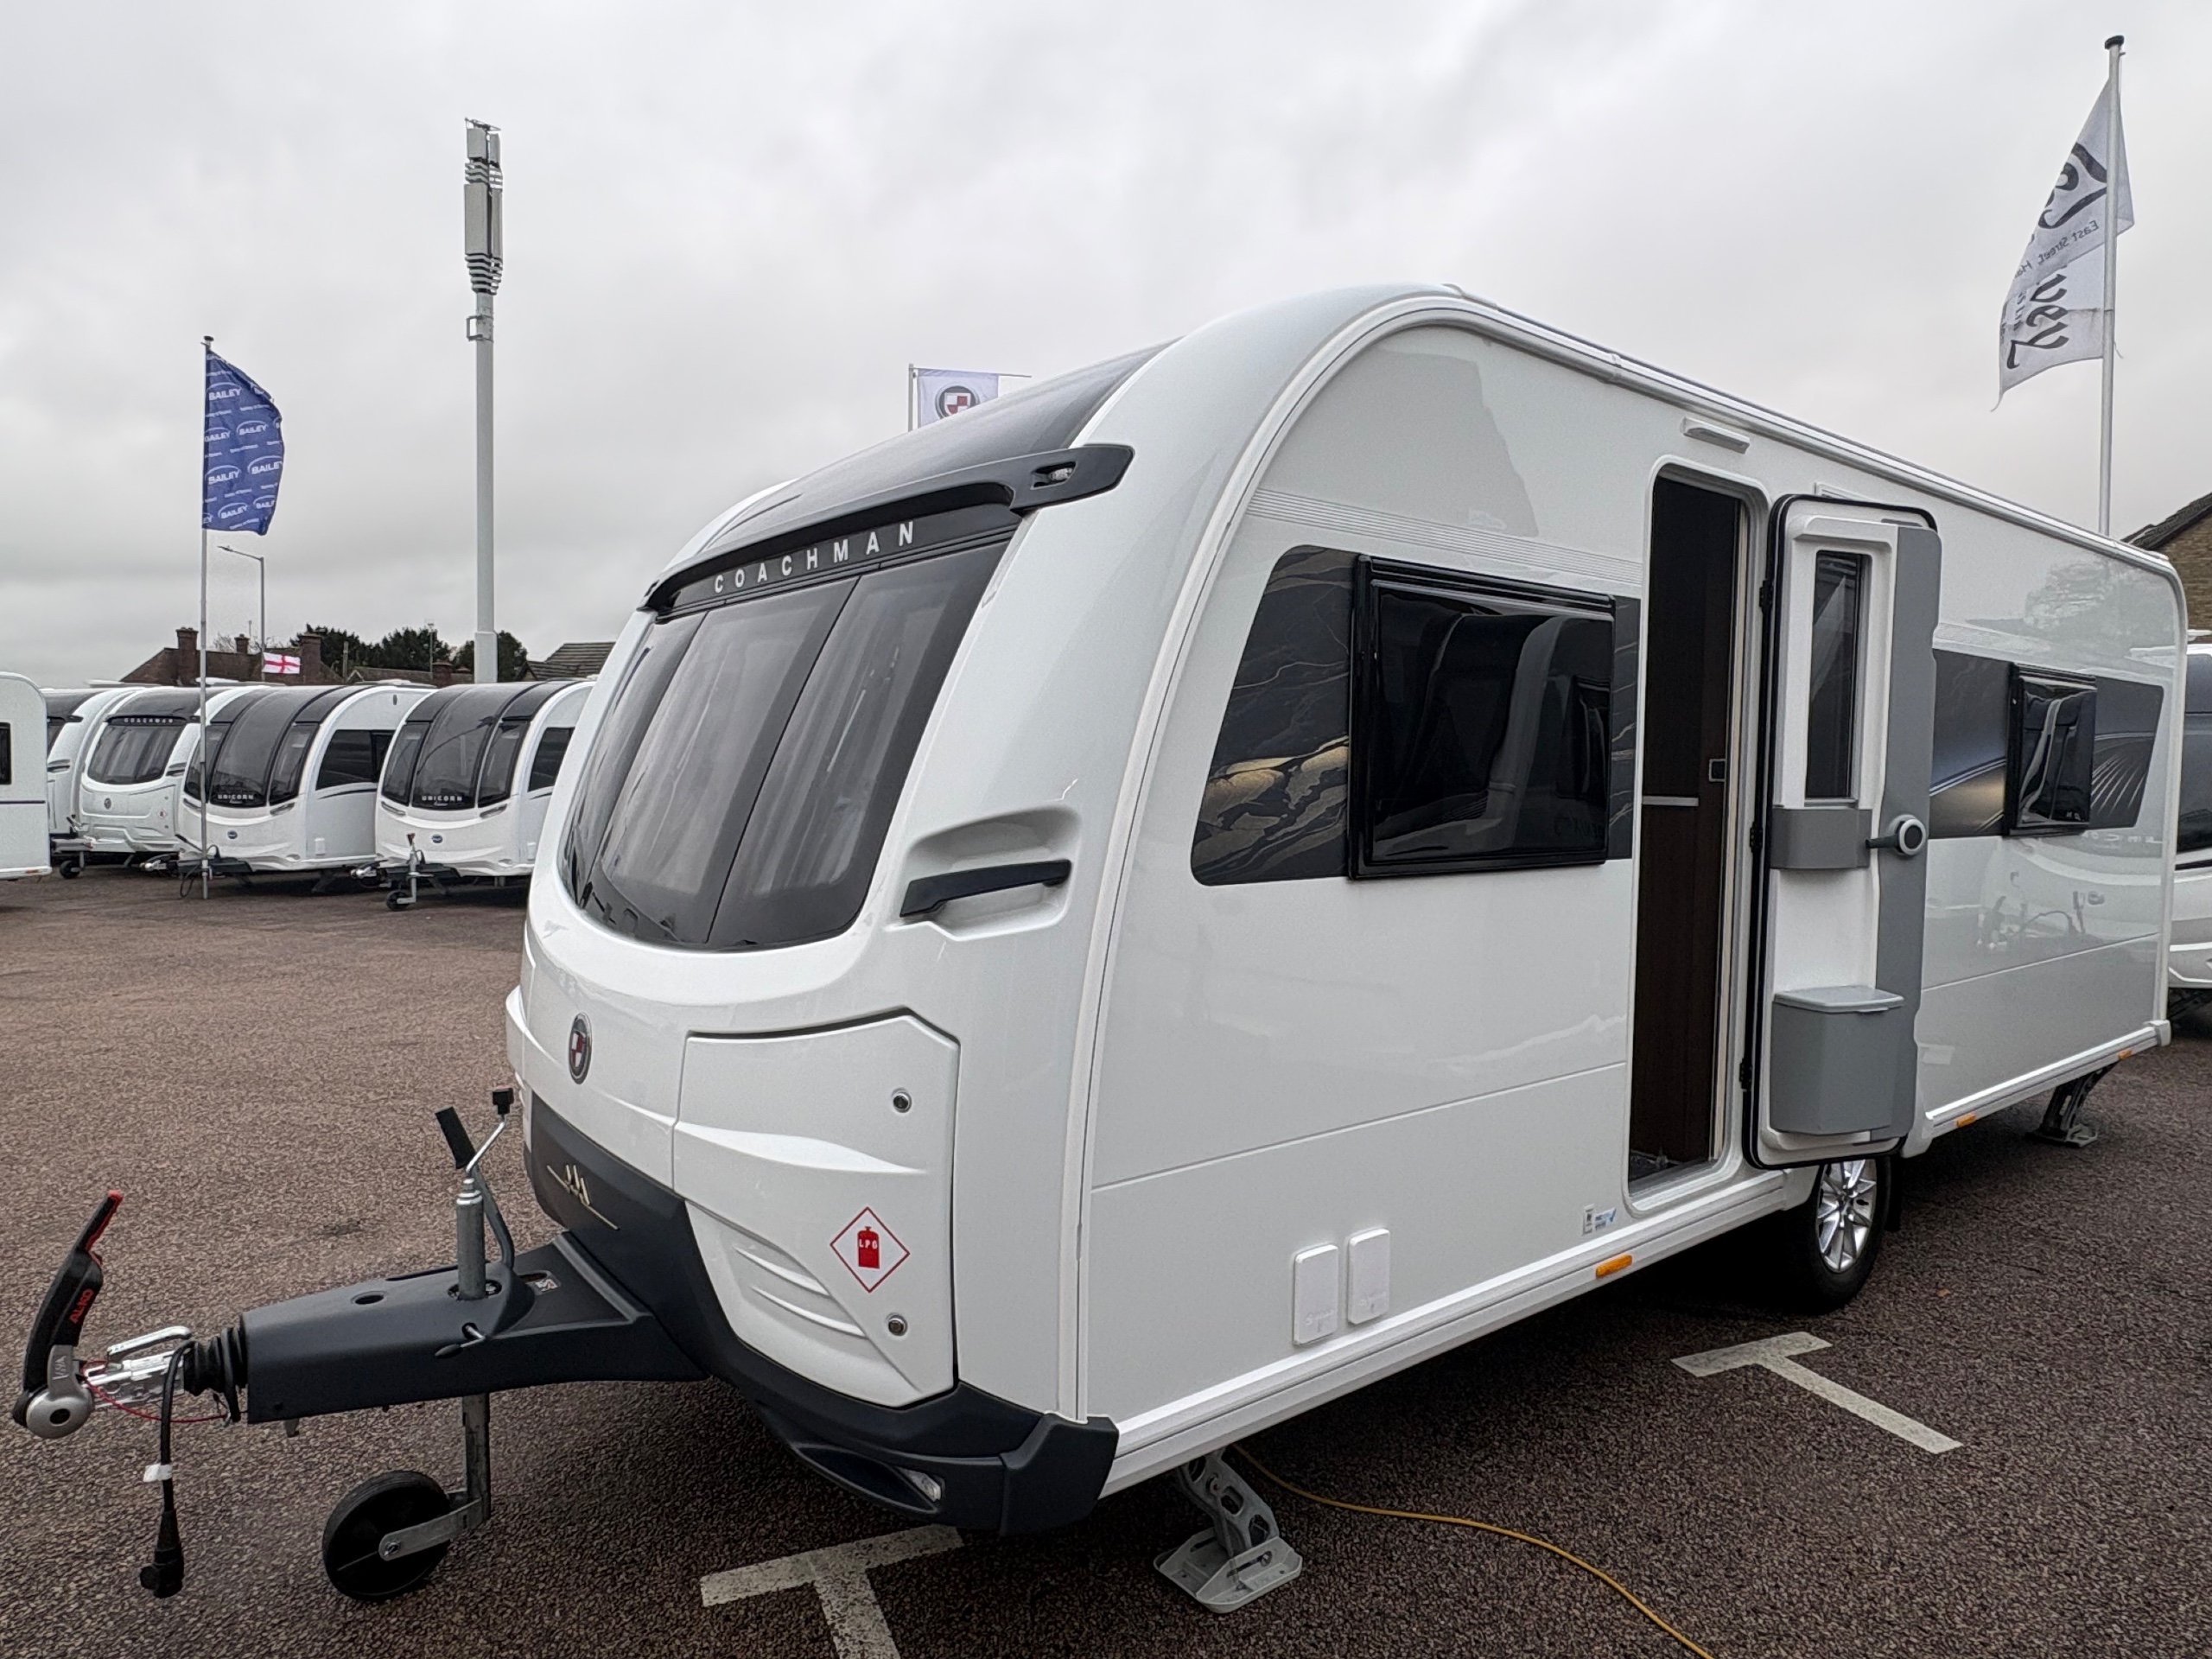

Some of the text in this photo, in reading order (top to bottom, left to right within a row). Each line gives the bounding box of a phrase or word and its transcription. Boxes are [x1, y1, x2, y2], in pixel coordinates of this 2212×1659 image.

[208, 387, 242, 401] BAILEY
[239, 424, 268, 435] BAILEY
[208, 468, 240, 486] BAILEY
[221, 505, 248, 519] BAILEY
[714, 520, 914, 594] COACHMAN
[859, 1238, 878, 1250] LPG
